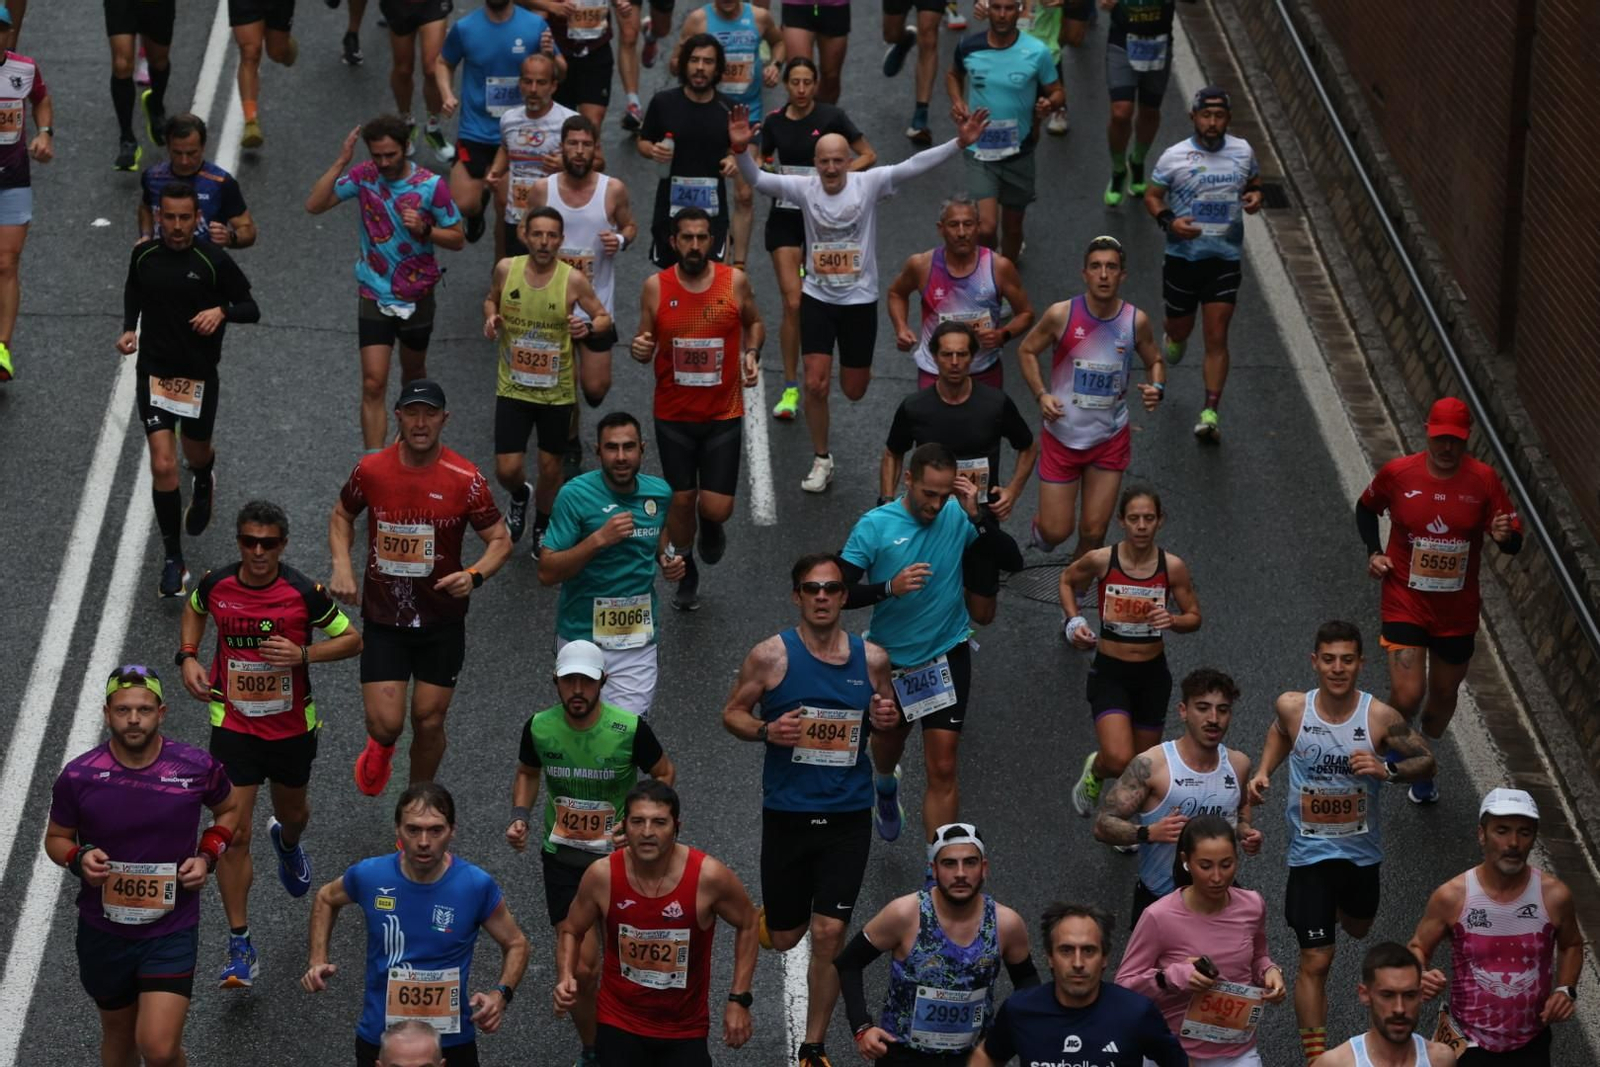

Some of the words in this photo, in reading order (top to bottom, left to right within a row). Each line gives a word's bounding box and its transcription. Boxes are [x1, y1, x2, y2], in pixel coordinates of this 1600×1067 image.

[679, 188, 706, 201] 2471
[819, 254, 848, 267] 5401
[517, 351, 548, 367] 5323
[684, 352, 708, 365] 289
[158, 377, 191, 395] 4552
[1082, 372, 1111, 389] 1782
[383, 536, 420, 553] 5707
[1420, 553, 1457, 570] 5559
[599, 608, 643, 627] 13066
[237, 675, 277, 692] 5082
[903, 670, 938, 696] 2245
[806, 722, 847, 741] 4894
[547, 766, 571, 778] MEDIO
[573, 768, 617, 781] MARATÓN
[1311, 798, 1352, 815] 6089
[562, 811, 600, 831] 4219
[113, 878, 159, 898] 4665
[628, 942, 671, 962] 3762
[399, 986, 445, 1006] 6357
[925, 1003, 970, 1024] 2993
[1199, 994, 1248, 1020] 5497
[1066, 1039, 1080, 1048] JIG
